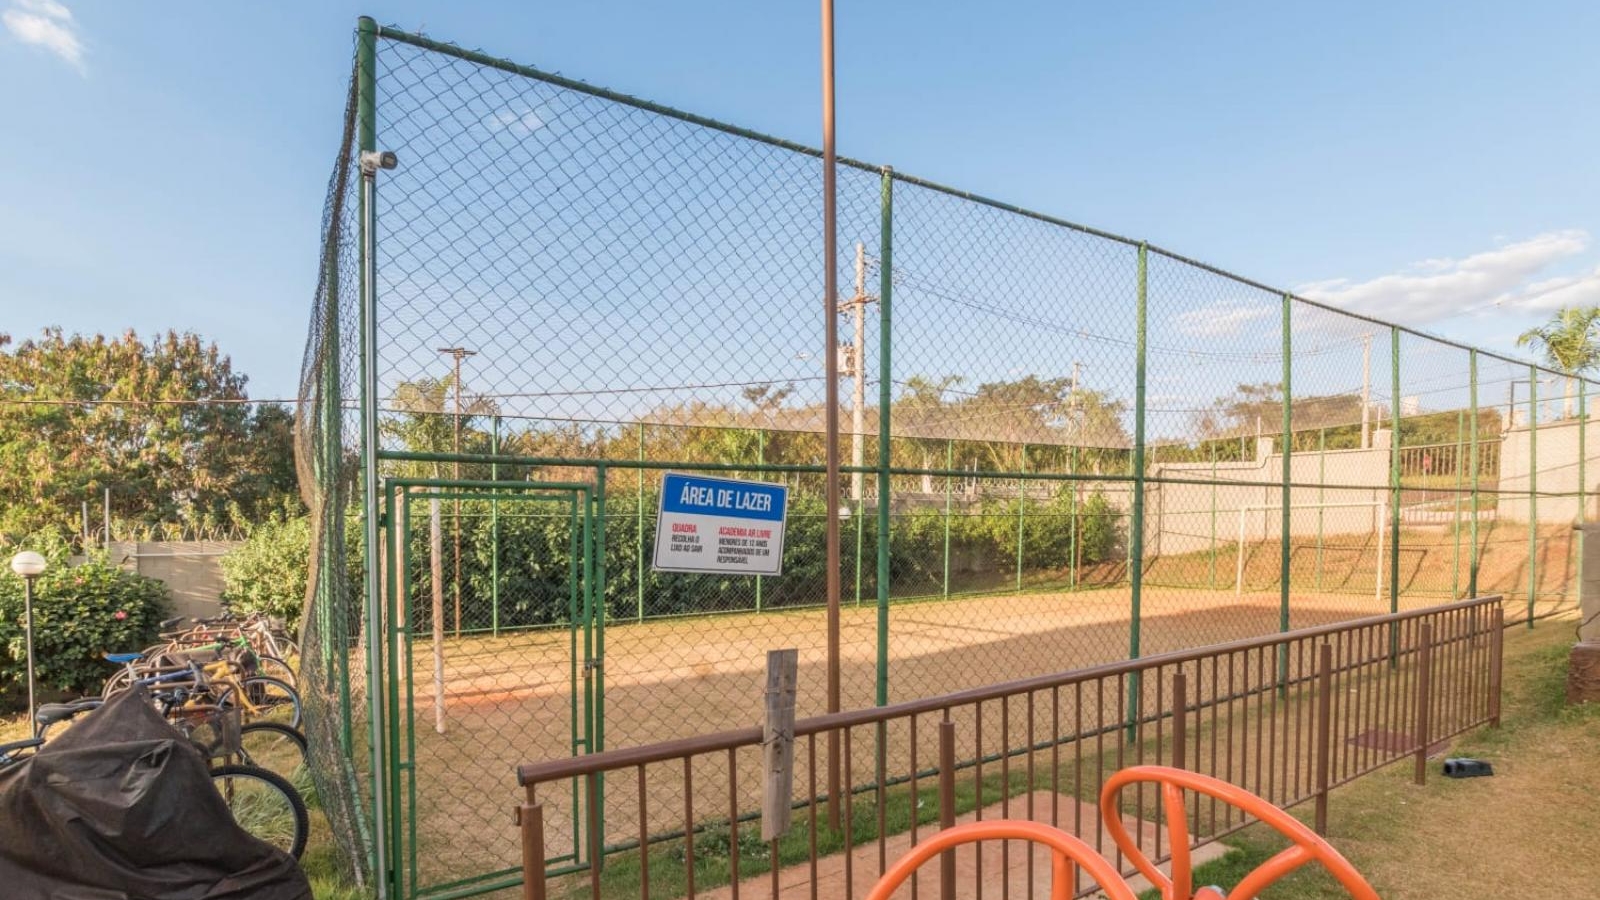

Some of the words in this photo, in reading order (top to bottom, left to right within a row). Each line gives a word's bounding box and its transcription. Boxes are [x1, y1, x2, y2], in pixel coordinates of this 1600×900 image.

[680, 481, 714, 507] ÁREA
[717, 488, 733, 509] DE
[735, 490, 772, 512] LAZER
[672, 523, 697, 533] QUADRA
[719, 526, 747, 537] ACADEMIA
